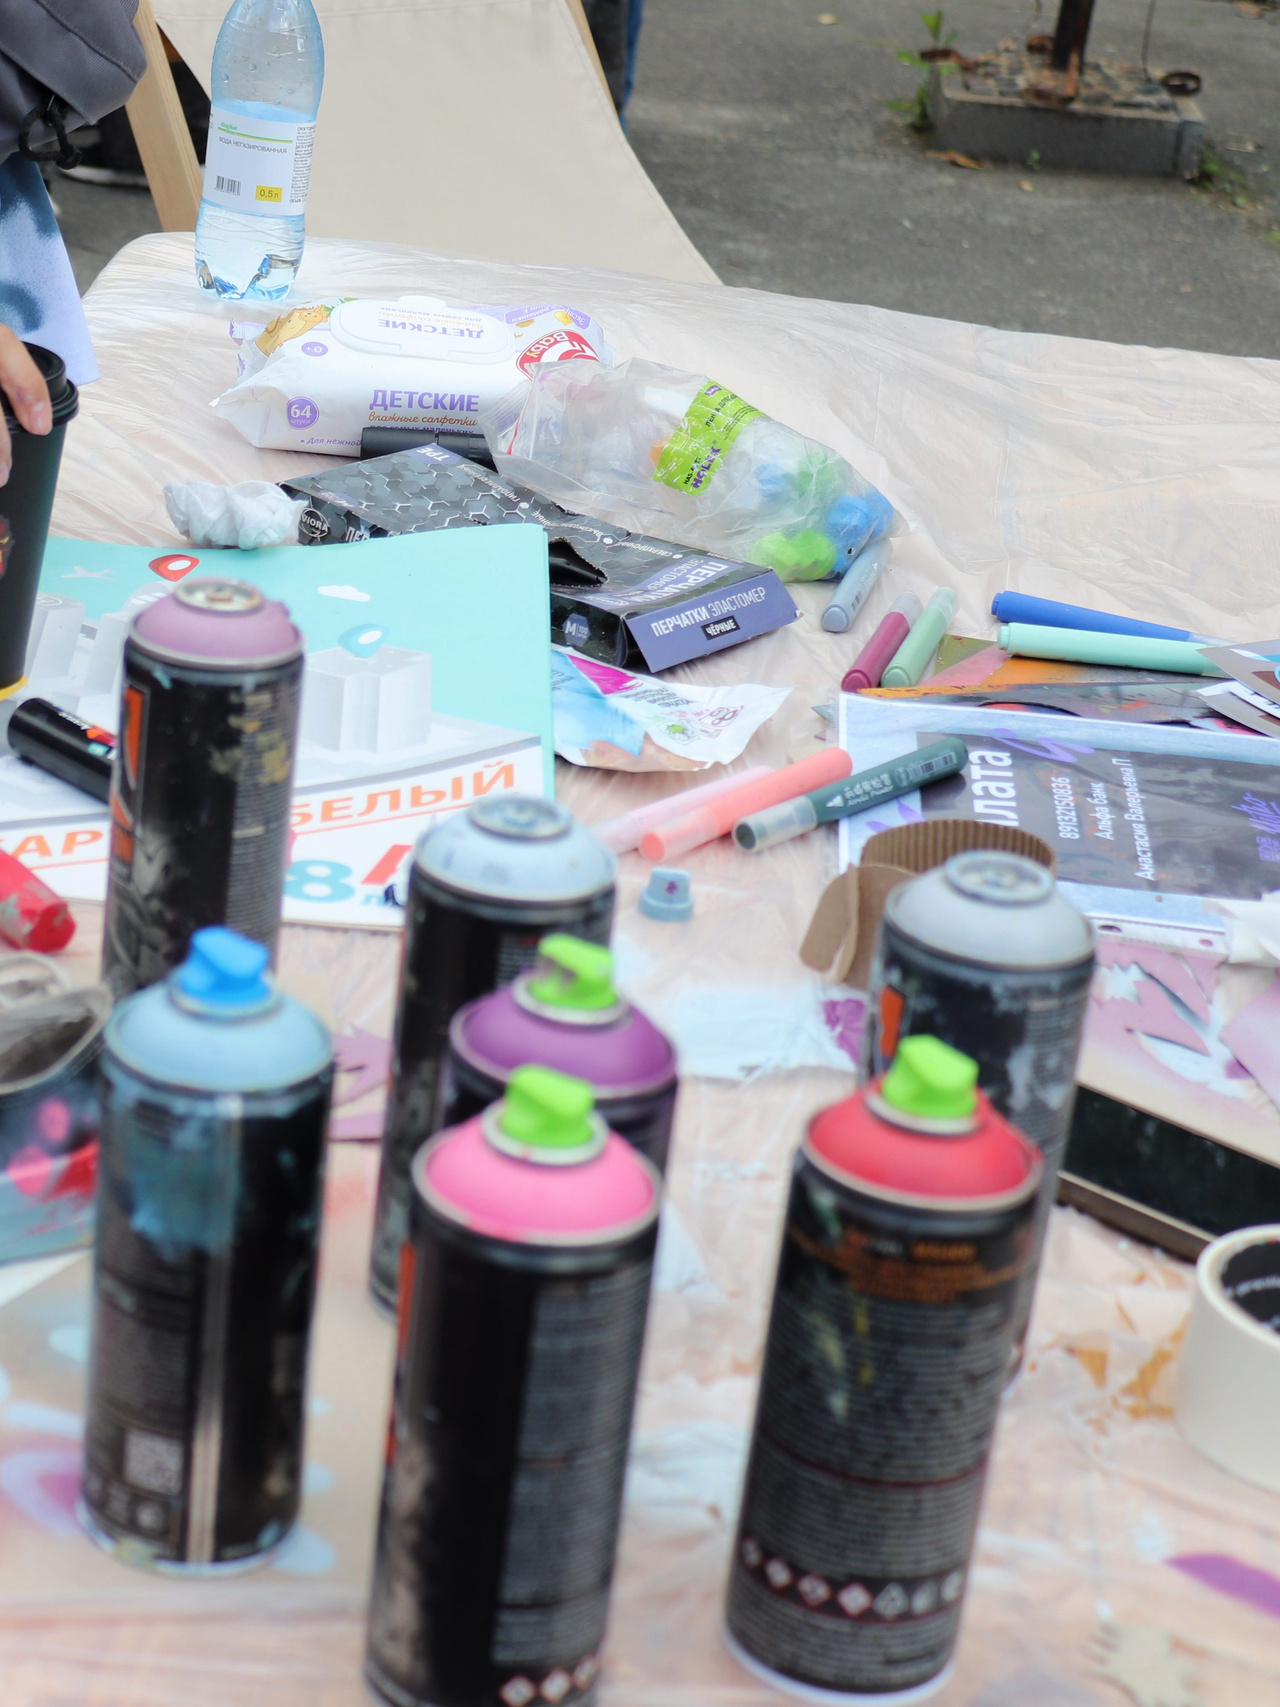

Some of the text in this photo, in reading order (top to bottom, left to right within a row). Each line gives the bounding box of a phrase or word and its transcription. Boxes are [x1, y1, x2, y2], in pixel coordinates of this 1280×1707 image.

[233, 140, 288, 154] НЕГАЗИРОВАННАЯ
[259, 188, 273, 198] 0,5
[378, 319, 484, 338] ДЕТСКИЕ
[526, 331, 570, 358] Baby
[290, 404, 311, 418] 64
[368, 389, 480, 412] ДЕТСКИЕ
[368, 411, 478, 426] влажные салфетки
[306, 437, 361, 447] Для нежной
[301, 514, 328, 532] VIORA
[634, 560, 730, 603] ПЕРЧАТКИ
[650, 586, 766, 637] ПЕРЧАТКИ ЭЛАСТОМЕР
[705, 619, 737, 636] ЧЁРНЫЕ
[290, 760, 515, 827] БЕЛЫЙ
[1051, 777, 1080, 840] 89132150836
[1086, 782, 1116, 840] Альфа банк
[1111, 758, 1157, 881] Анастасия Валерьевна П
